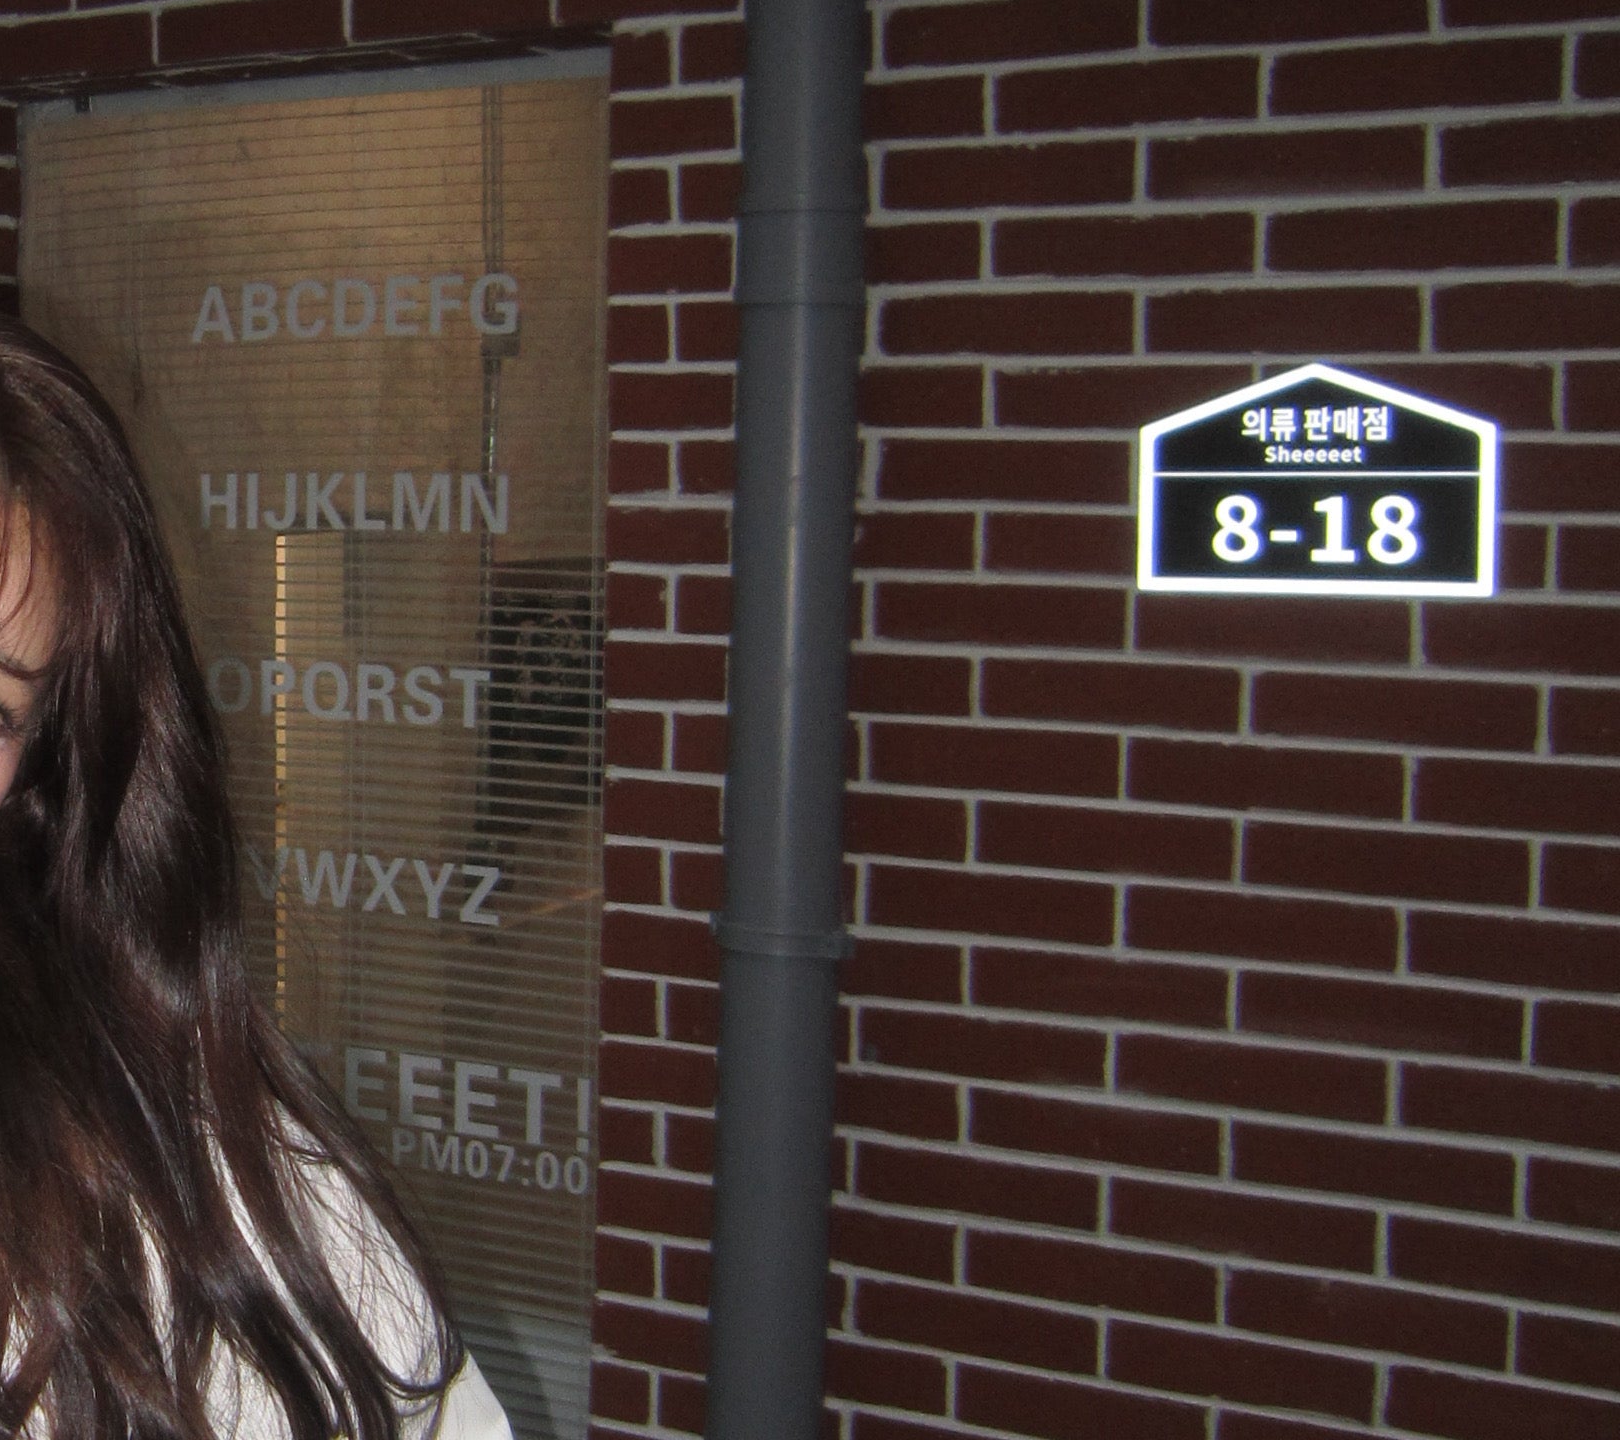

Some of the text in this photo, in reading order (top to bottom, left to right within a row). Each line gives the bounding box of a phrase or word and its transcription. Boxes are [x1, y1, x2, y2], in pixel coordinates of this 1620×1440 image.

[191, 272, 520, 344] ABCDEFG
[1241, 406, 1390, 442] 의류 판매점
[1264, 445, 1363, 463] Sheeeeet
[199, 472, 509, 534] HIJKLMN
[1212, 494, 1418, 565] 8-18
[208, 659, 491, 729] OPQRST
[298, 1039, 591, 1153] EEET!
